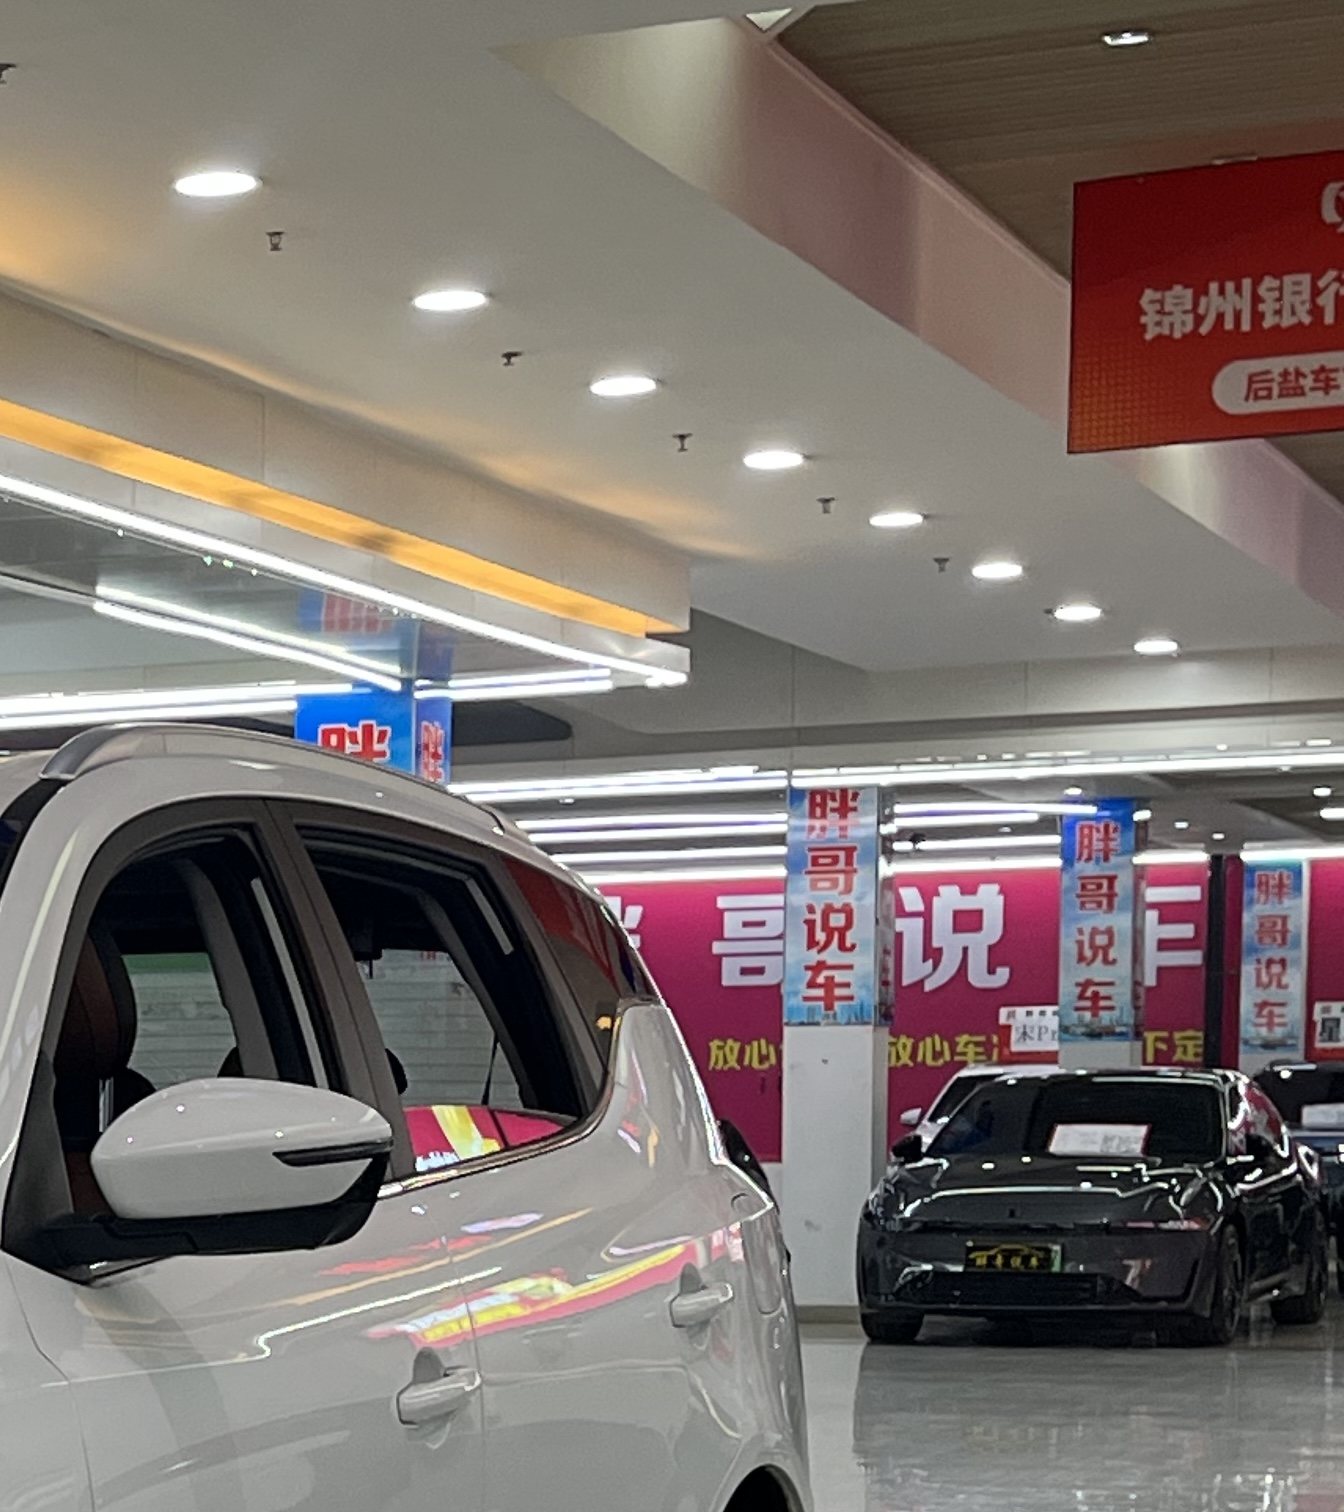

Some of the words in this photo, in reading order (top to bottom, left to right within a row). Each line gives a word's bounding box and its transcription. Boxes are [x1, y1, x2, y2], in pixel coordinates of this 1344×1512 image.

[1243, 363, 1344, 403] 后盐车
[801, 787, 862, 1013] 胖哥说车
[1072, 819, 1122, 1019] 胖哥说车
[1252, 868, 1294, 1034] 胖哥说车
[708, 1037, 777, 1071] 放心
[888, 1033, 1000, 1069] 放心车
